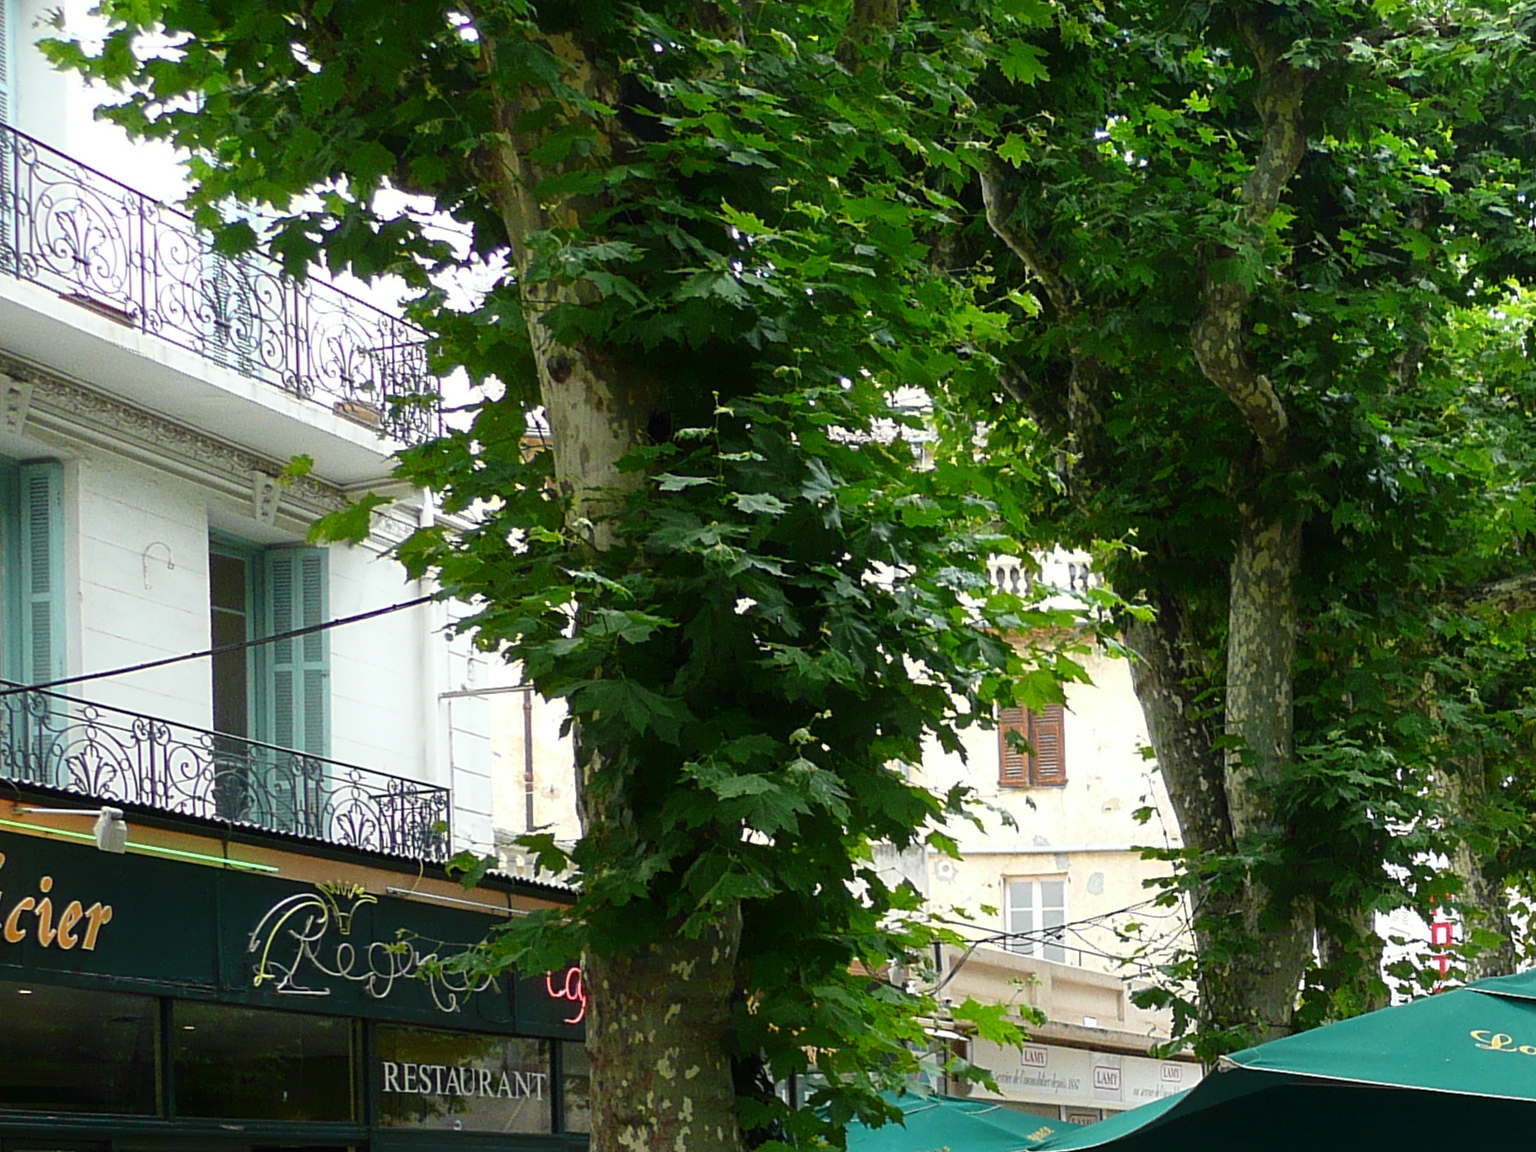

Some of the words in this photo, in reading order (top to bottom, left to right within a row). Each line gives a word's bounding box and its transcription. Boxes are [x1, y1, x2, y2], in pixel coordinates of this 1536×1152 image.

[0, 875, 113, 951] cier
[1024, 1049, 1045, 1064] LAMY
[382, 1061, 547, 1101] RESTAURANT
[1096, 1070, 1118, 1086] LAMY
